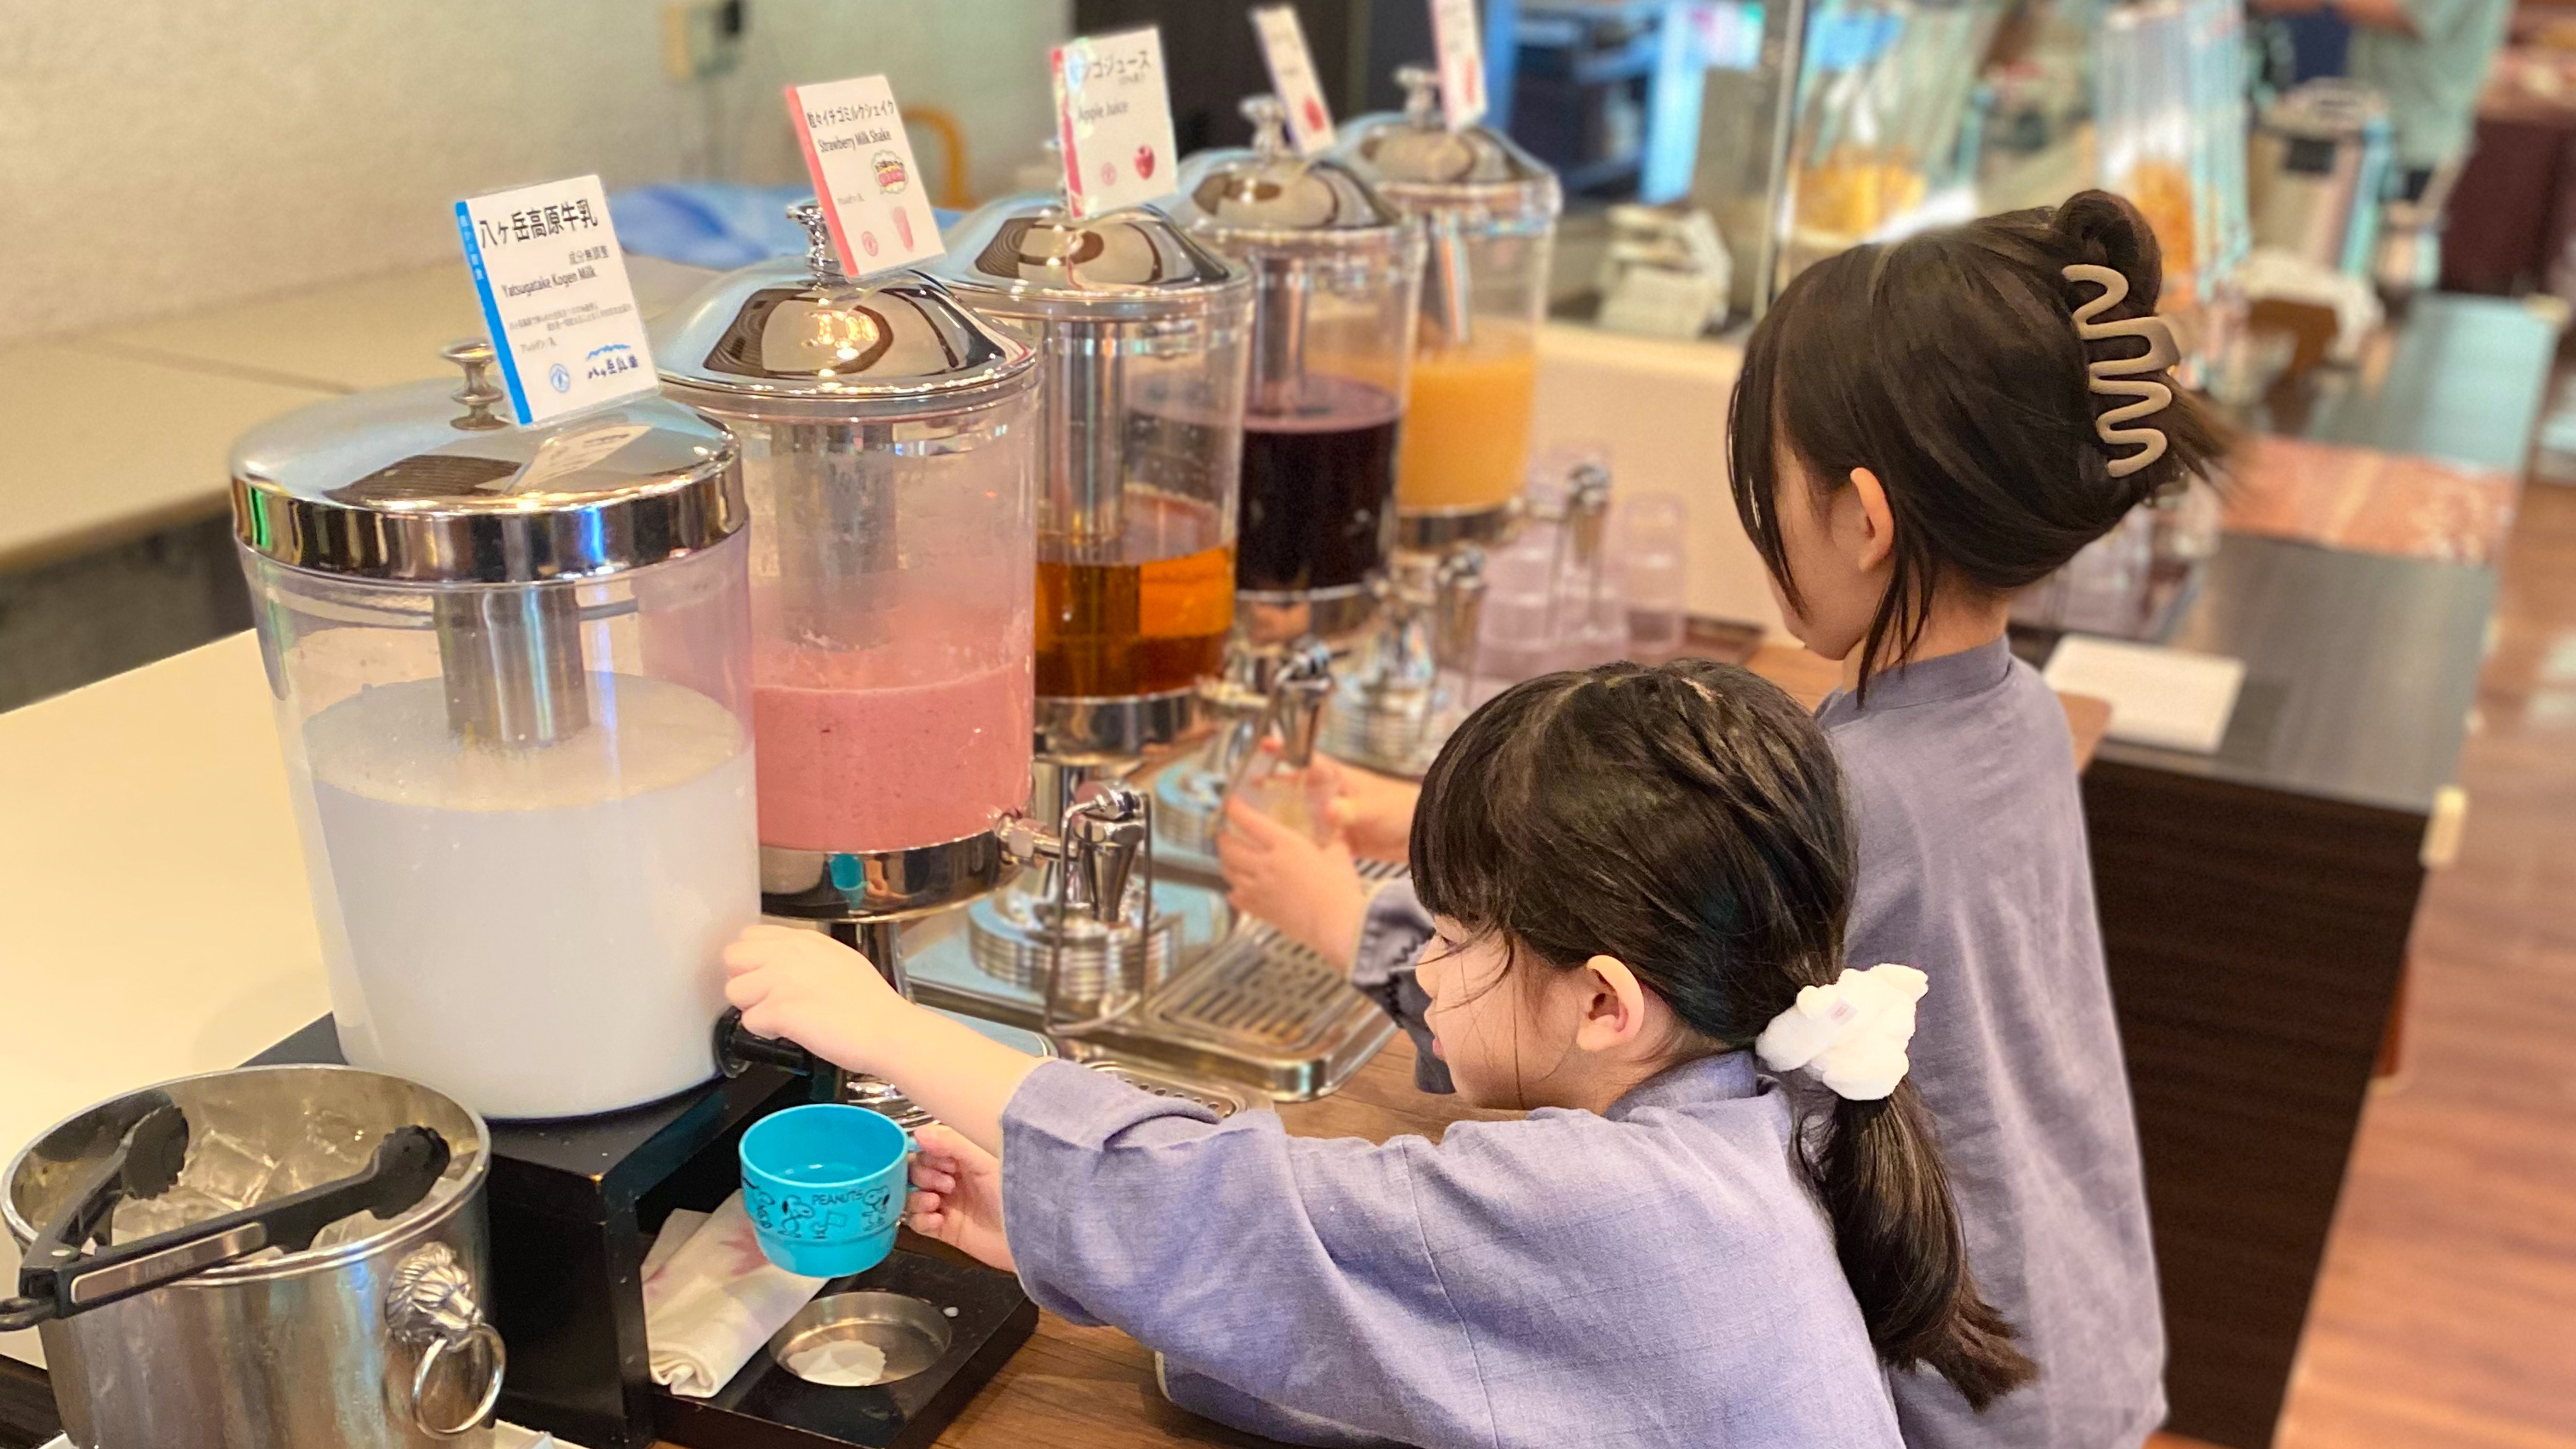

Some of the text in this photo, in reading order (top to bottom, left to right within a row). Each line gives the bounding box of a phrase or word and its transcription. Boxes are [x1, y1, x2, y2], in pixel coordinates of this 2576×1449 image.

[818, 126, 892, 152] Strawberry Milk Shake
[479, 198, 598, 249] 八ヶ岳高原牛乳
[501, 264, 597, 298] Yatsugatake Kogen Milk
[812, 1190, 863, 1206] PEANUTS
